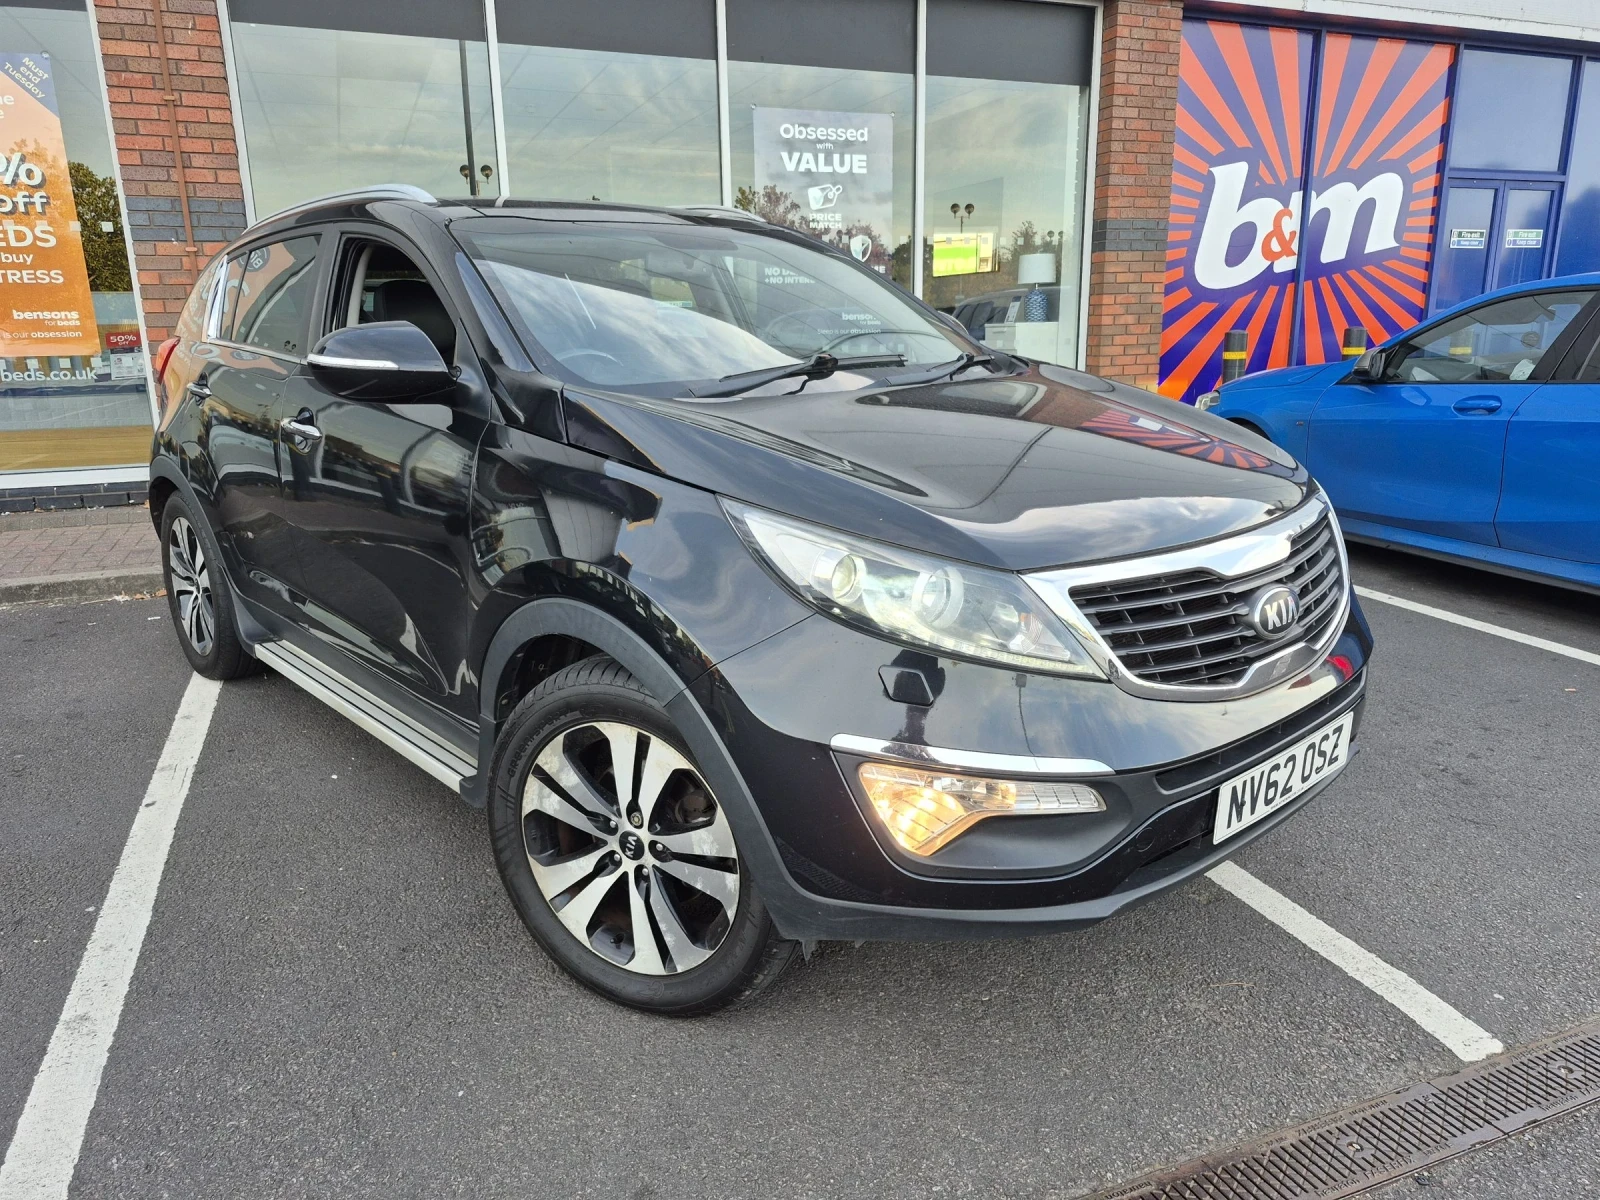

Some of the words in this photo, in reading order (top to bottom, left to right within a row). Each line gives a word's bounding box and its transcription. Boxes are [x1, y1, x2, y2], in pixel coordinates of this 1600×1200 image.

[20, 66, 40, 84] end
[22, 58, 48, 80] Must
[4, 62, 46, 98] Tuesday
[780, 124, 868, 142] Obsessed
[780, 152, 868, 174] VALUE
[0, 191, 47, 213] off
[810, 213, 842, 221] PRICE
[1194, 161, 1404, 290] b&m
[1, 252, 33, 264] buy
[764, 268, 780, 276] NO
[12, 310, 79, 319] bensons
[842, 312, 876, 320] benso
[0, 367, 98, 381] beds.co.uk
[1264, 596, 1298, 630] KIA
[1227, 754, 1296, 829] NV62
[1301, 724, 1344, 784] OSZ
